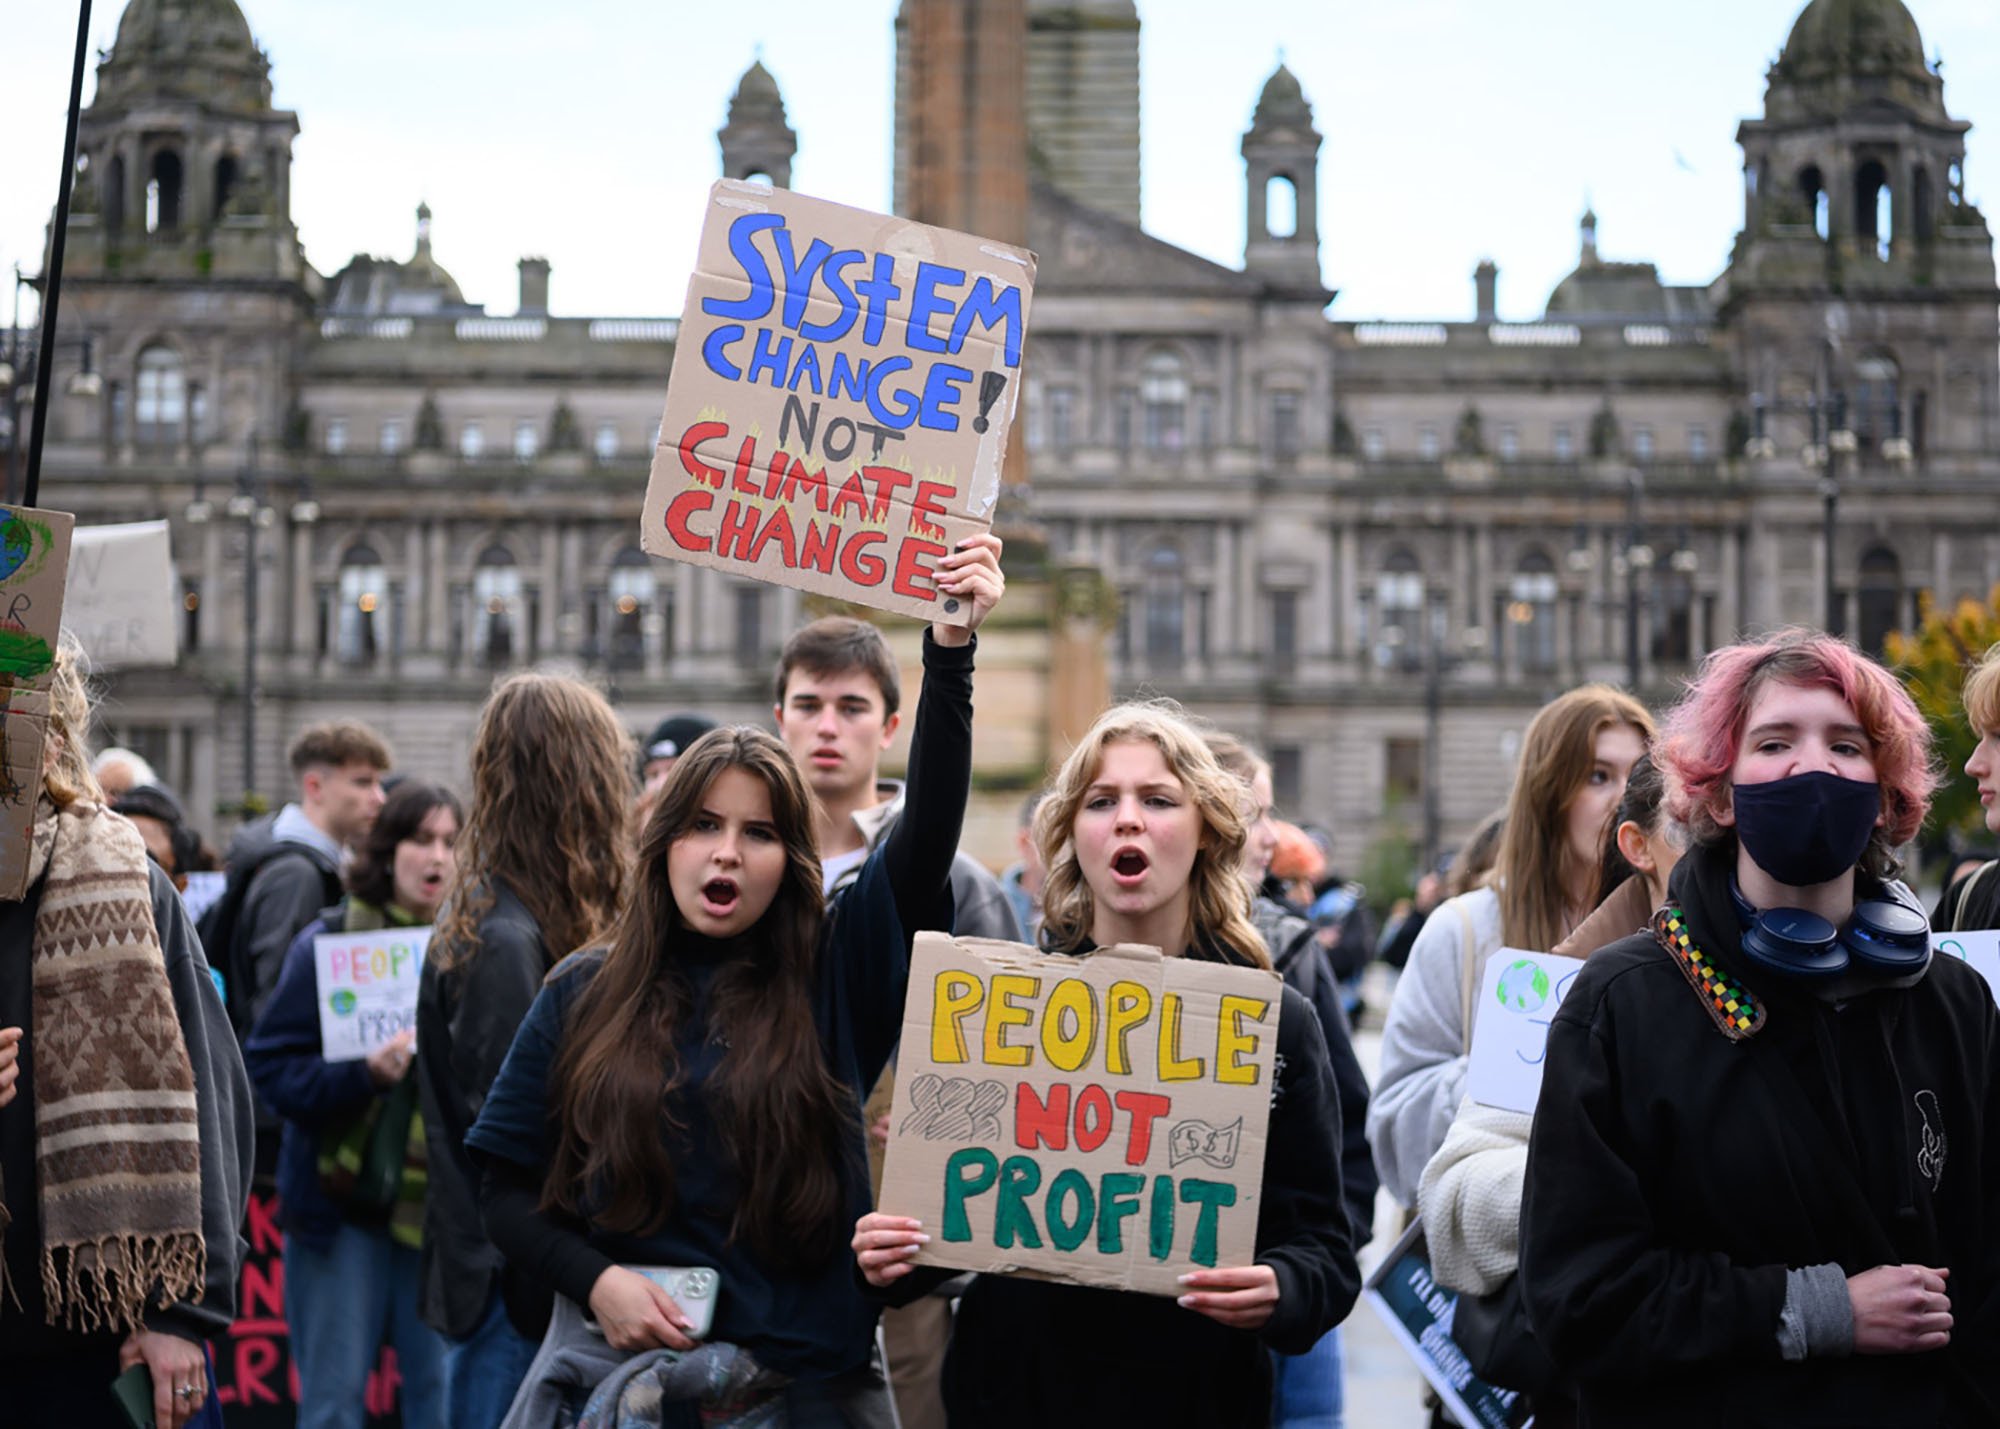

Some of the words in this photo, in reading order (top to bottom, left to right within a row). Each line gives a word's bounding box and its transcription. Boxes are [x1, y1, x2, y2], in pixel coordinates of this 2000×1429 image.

[678, 421, 957, 539] CLIMATE
[778, 394, 906, 462] NOT
[930, 970, 1270, 1086] PEOPLE
[1014, 1081, 1172, 1166] NOT
[941, 1147, 1237, 1268] PROFIT
